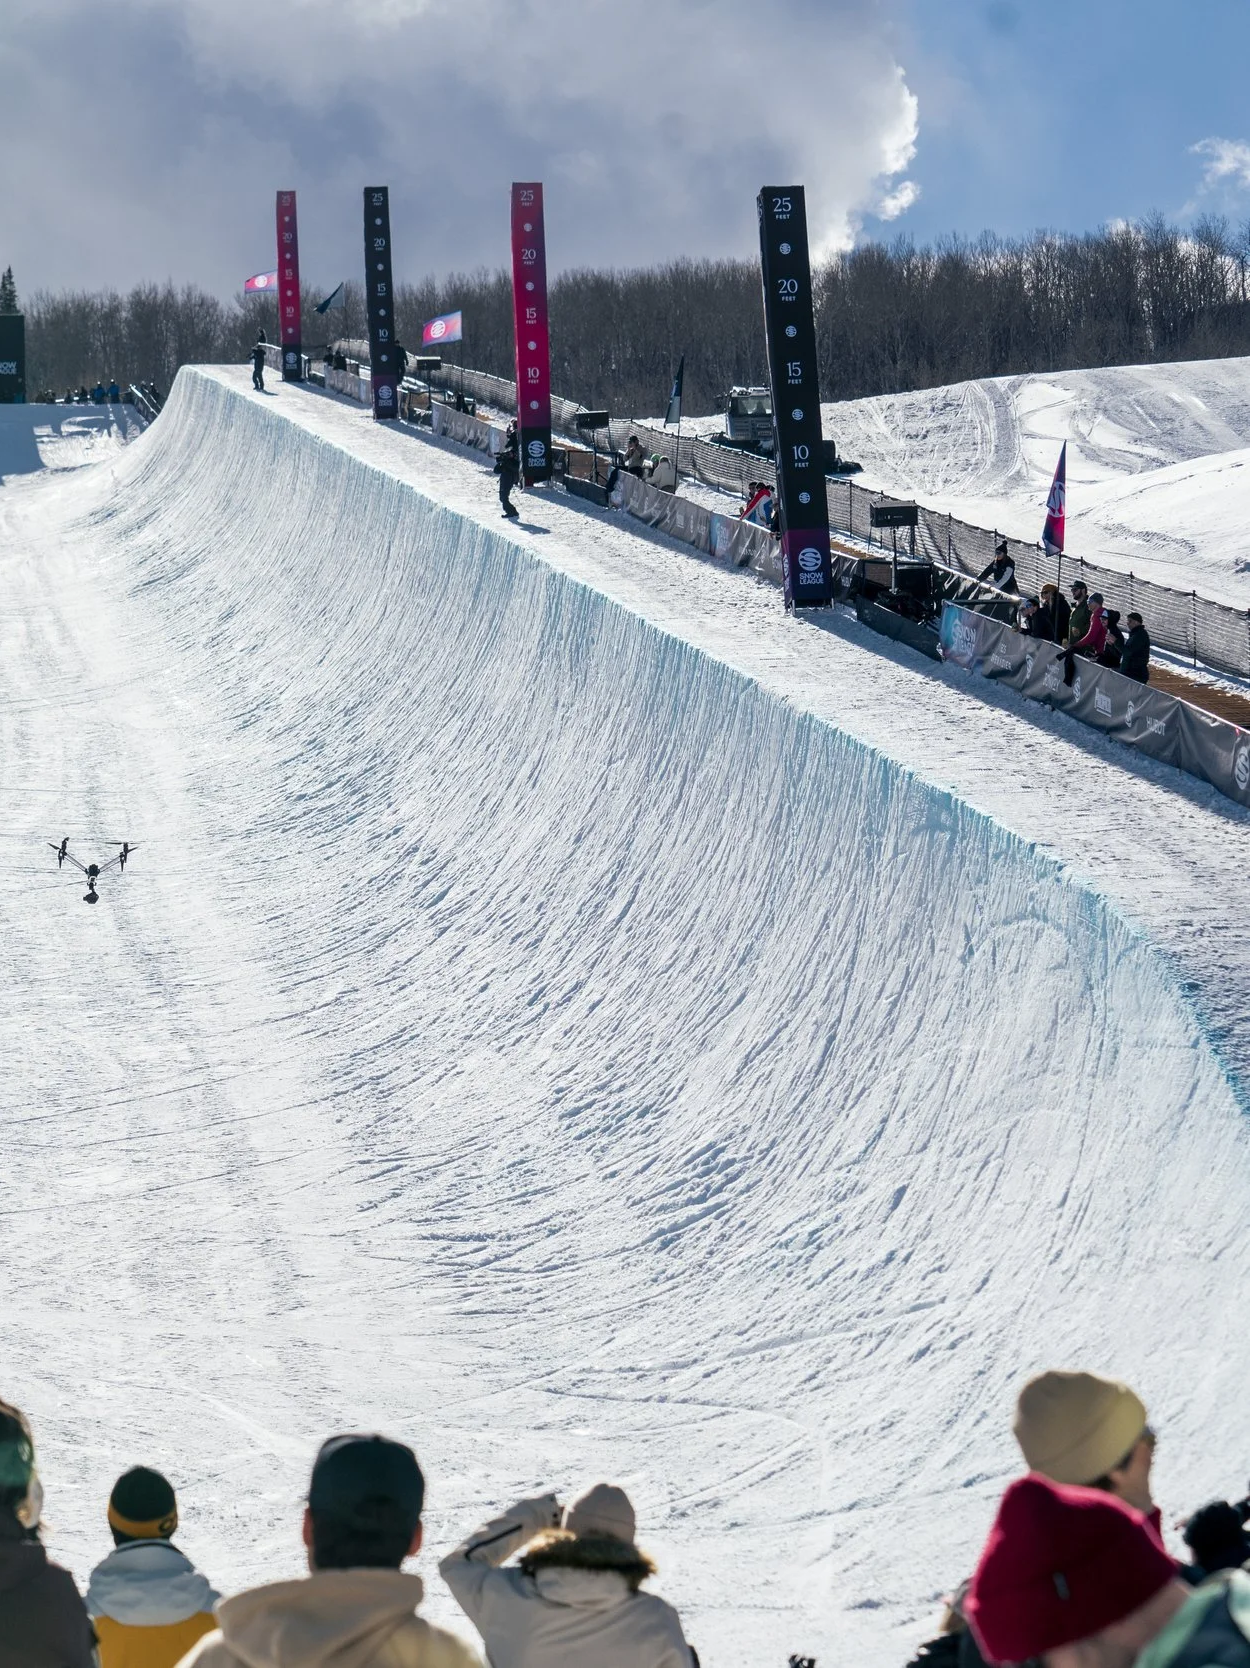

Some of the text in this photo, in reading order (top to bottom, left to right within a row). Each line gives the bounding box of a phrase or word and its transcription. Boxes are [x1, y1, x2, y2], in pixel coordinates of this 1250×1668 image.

[373, 193, 383, 201] 25
[520, 190, 533, 200] 25
[773, 198, 791, 212] 25
[374, 238, 385, 246] 20
[522, 249, 536, 259] 20
[378, 283, 385, 291] 15
[778, 279, 798, 293] 20
[526, 308, 536, 318] 15
[379, 329, 388, 337] 10
[528, 368, 539, 378] 10
[787, 362, 801, 376] 15
[793, 445, 808, 459] 10
